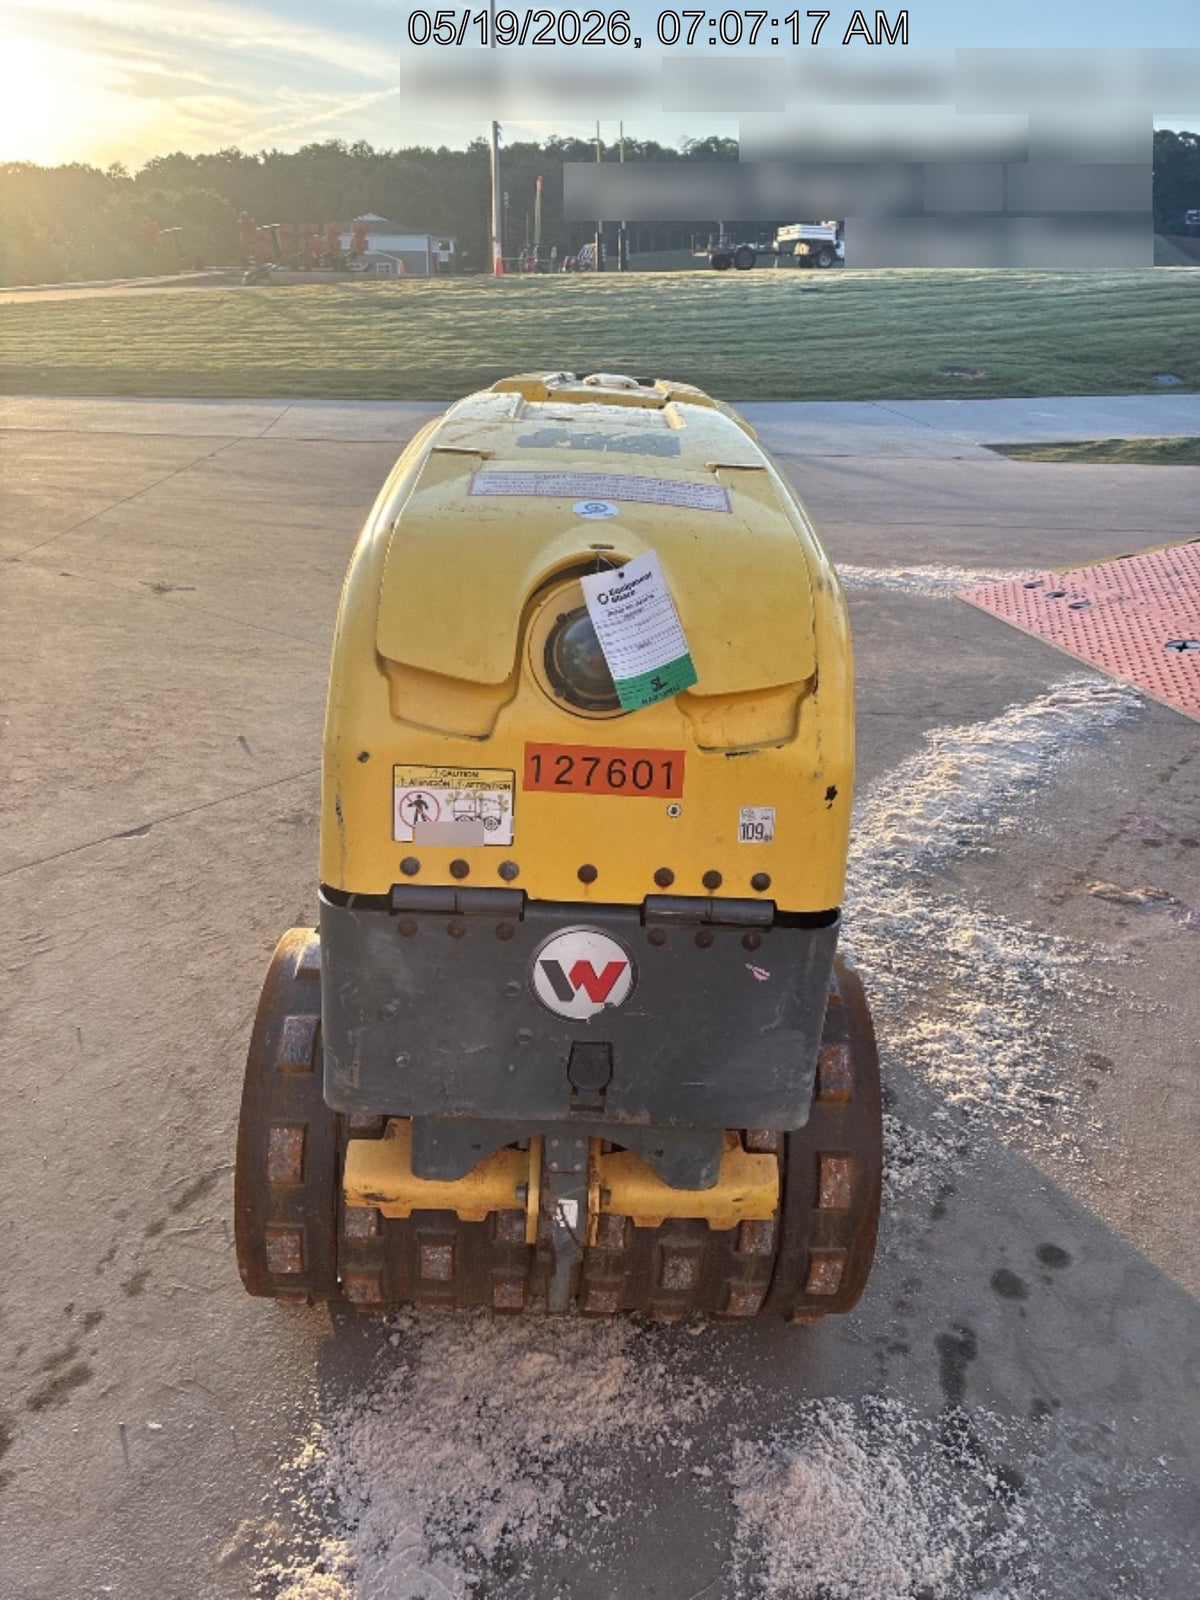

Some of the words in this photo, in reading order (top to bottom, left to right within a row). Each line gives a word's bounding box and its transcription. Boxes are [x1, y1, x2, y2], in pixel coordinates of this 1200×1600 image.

[441, 769, 479, 778] CAUTION
[530, 754, 673, 790] 127601
[741, 823, 764, 840] 109
